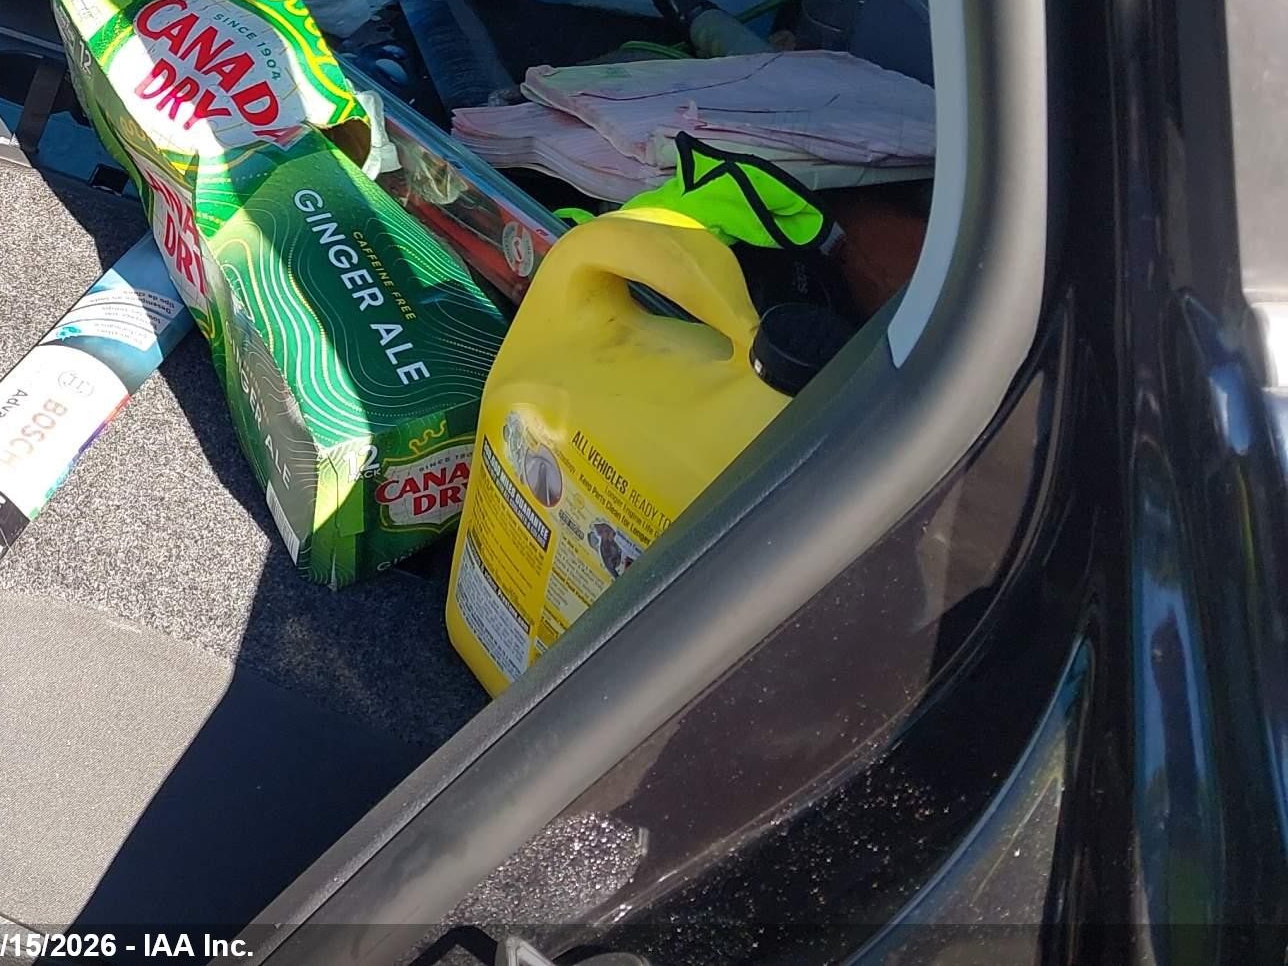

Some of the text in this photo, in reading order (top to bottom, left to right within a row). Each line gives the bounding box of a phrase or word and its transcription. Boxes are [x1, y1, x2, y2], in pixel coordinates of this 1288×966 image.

[213, 13, 282, 80] SINCE 1904
[134, 57, 233, 131] DRY
[293, 189, 431, 385] GINGER ALE
[352, 231, 417, 321] CAFFEINE FREE
[264, 433, 292, 490] ALE
[342, 444, 380, 475] 12
[375, 461, 472, 504] CANA
[572, 430, 588, 456] ALL
[587, 444, 629, 495] VEHICLES
[628, 488, 659, 522] READY
[413, 483, 469, 517] DR
